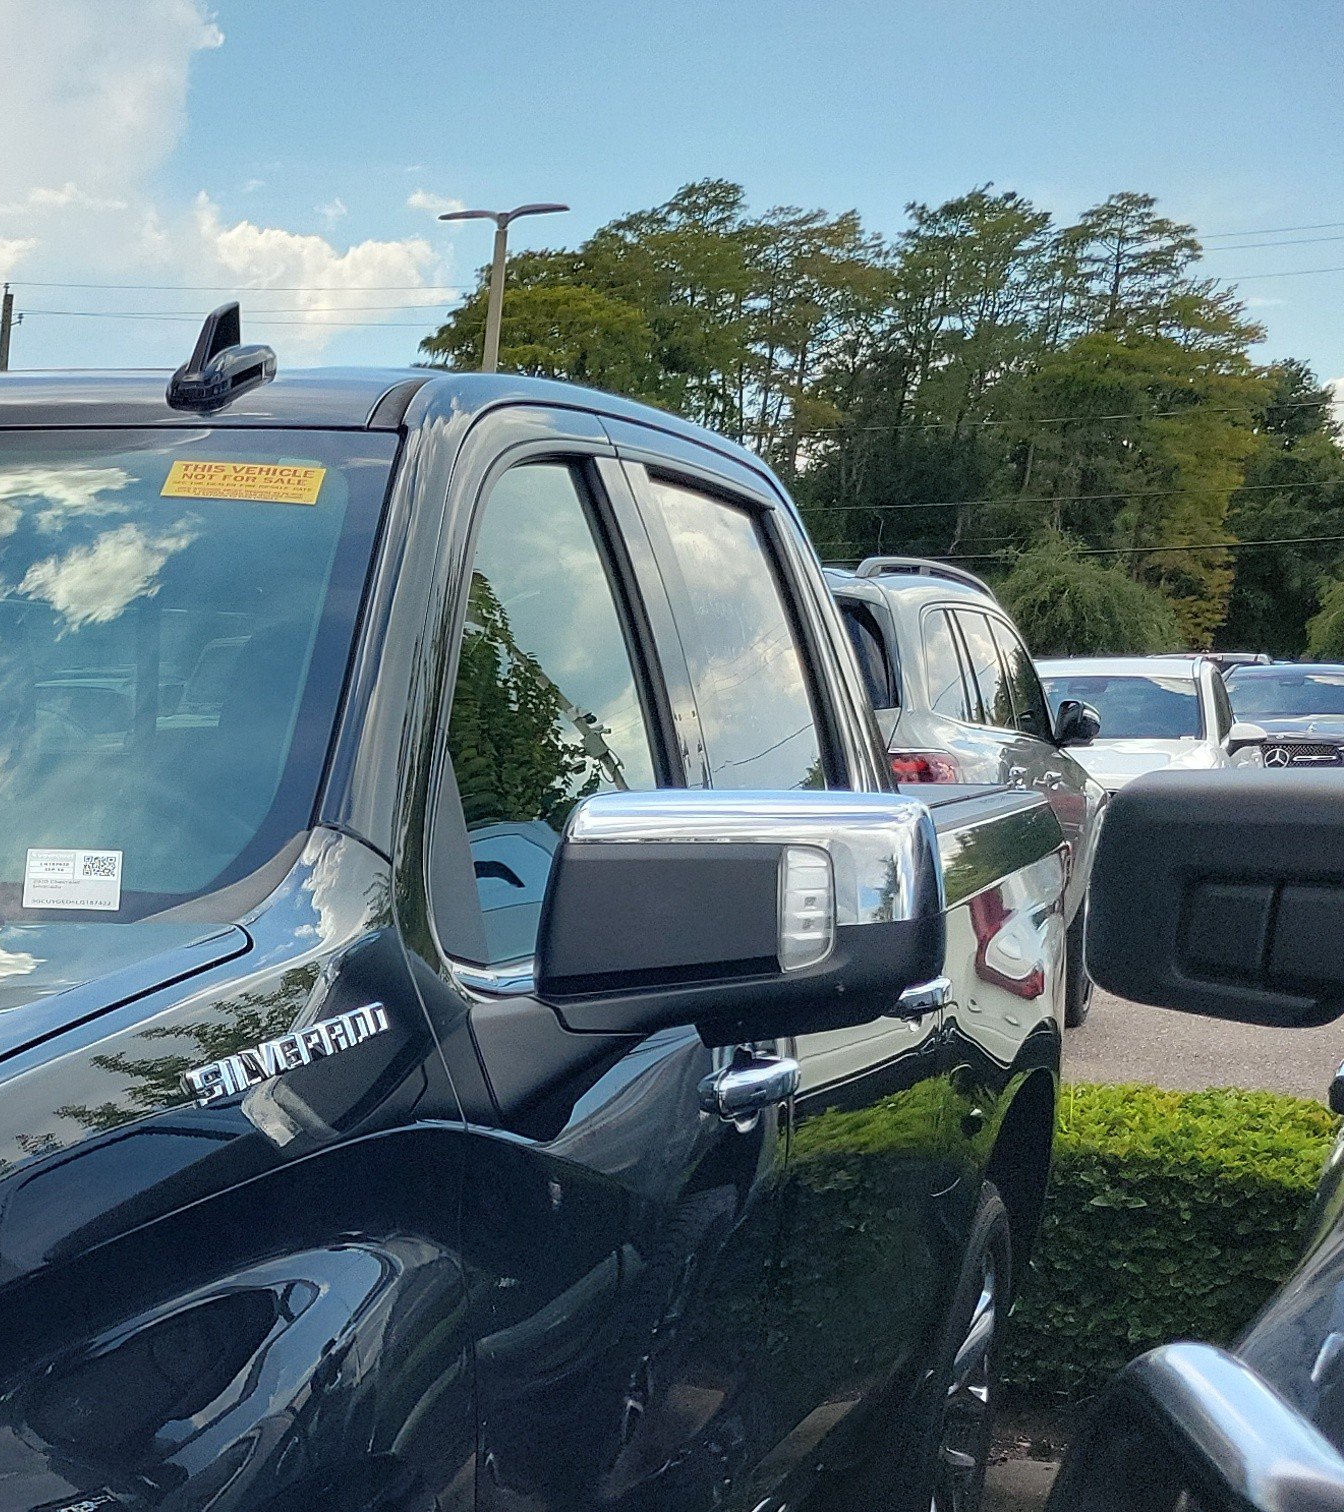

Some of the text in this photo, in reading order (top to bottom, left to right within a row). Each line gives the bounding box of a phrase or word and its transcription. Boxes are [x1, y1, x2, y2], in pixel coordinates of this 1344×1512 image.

[182, 463, 315, 479] THIS VEHICLE
[182, 473, 308, 487] NOT FOR SALE
[185, 1002, 389, 1106] SILVERADO
